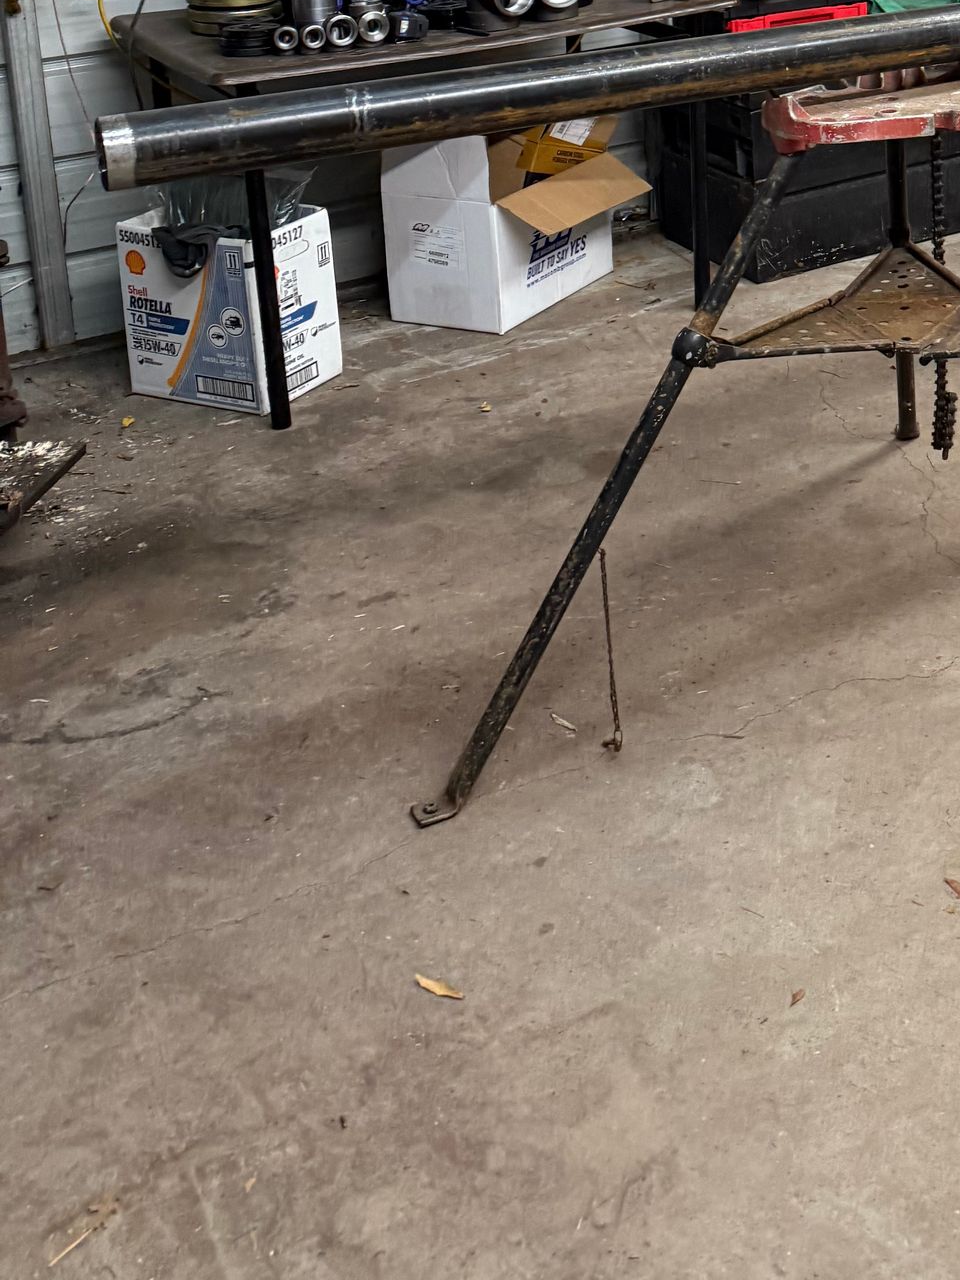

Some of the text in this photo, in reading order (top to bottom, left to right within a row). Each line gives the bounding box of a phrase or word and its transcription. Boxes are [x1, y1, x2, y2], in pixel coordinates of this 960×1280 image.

[526, 259, 546, 281] BUILT
[546, 254, 556, 269] TO
[556, 246, 570, 264] SAY
[570, 234, 587, 257] YES
[128, 285, 148, 297] Shell
[129, 296, 172, 315] ROTELLA
[130, 312, 144, 325] T4
[143, 338, 176, 355] 15W-40
[282, 332, 304, 352] W-40
